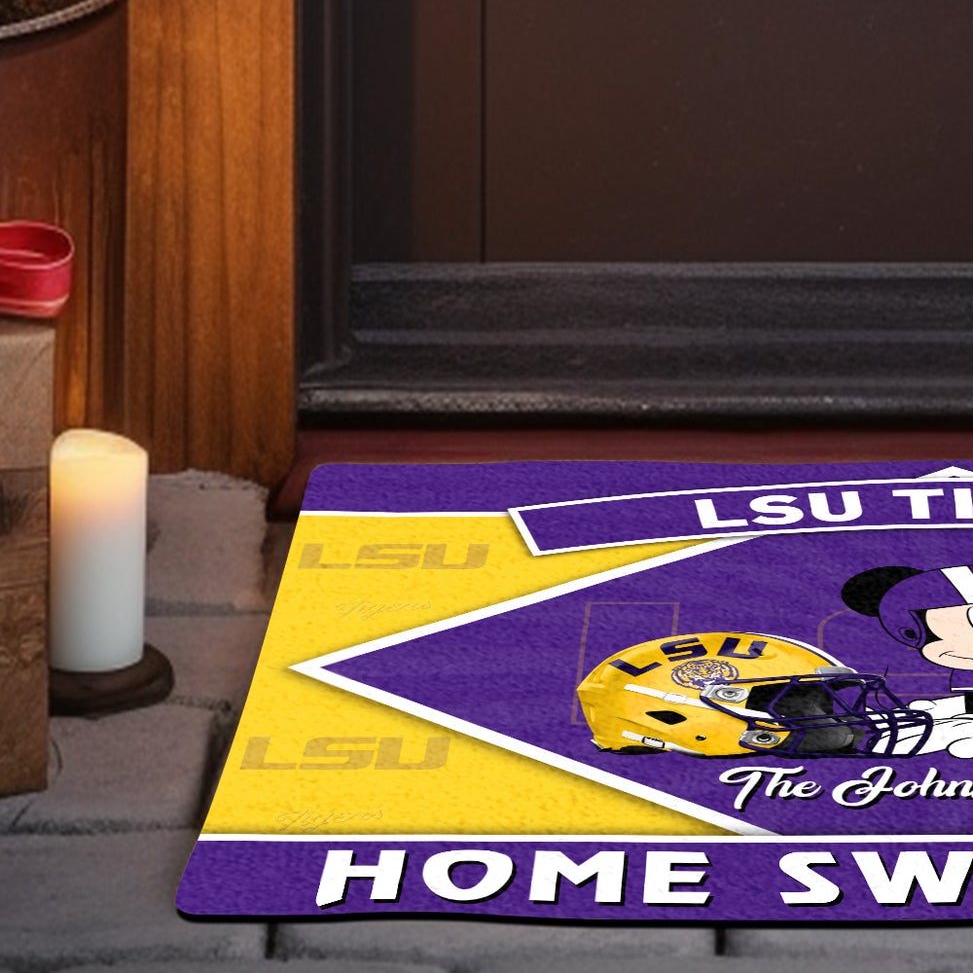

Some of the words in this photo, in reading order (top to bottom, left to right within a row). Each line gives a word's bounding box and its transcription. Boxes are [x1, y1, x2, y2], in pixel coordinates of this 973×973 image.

[695, 491, 863, 529] LSU
[298, 543, 490, 570] LSU
[610, 637, 768, 677] LSU
[240, 736, 450, 770] LSU
[718, 765, 822, 811] The
[315, 849, 711, 908] HOME
